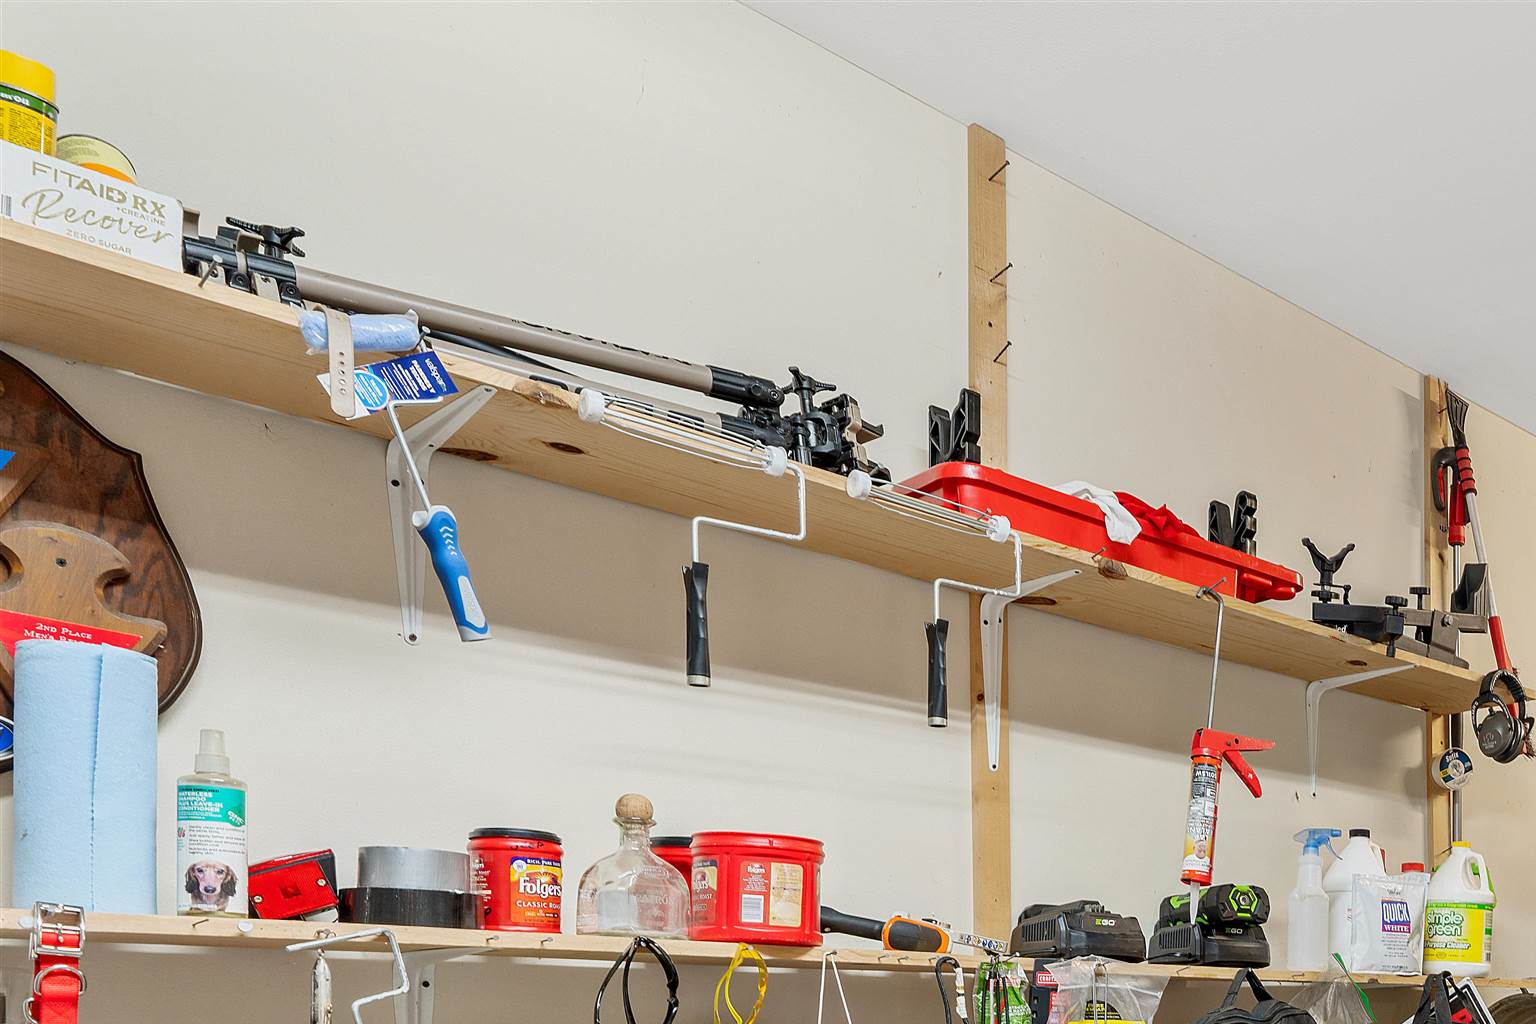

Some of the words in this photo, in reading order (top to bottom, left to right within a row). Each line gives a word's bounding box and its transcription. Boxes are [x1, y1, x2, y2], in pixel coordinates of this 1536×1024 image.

[32, 161, 127, 204] FITAID
[132, 194, 167, 219] RX
[21, 188, 175, 243] Recover
[66, 228, 96, 244] ZERO
[99, 238, 132, 256] SUGAR
[35, 622, 58, 633] 2ND
[61, 627, 93, 640] PLACE
[519, 876, 561, 898] Folgers
[516, 900, 547, 909] CLASSIC
[1382, 903, 1410, 923] QUICK
[1095, 918, 1116, 927] EGO
[1427, 910, 1464, 926] simple
[1225, 927, 1243, 935] EGO
[1383, 924, 1410, 932] WHITE
[1427, 924, 1463, 938] green
